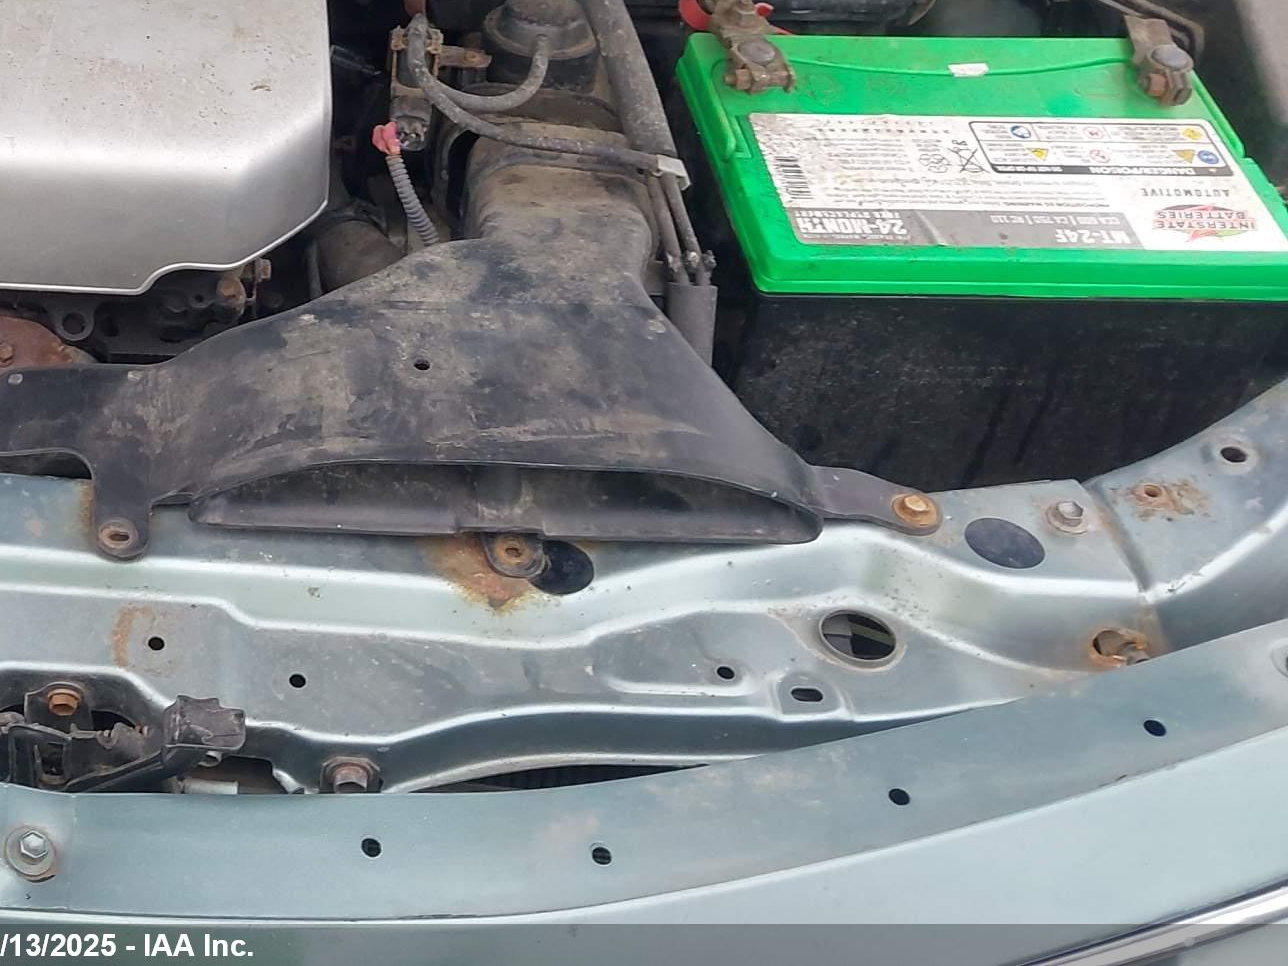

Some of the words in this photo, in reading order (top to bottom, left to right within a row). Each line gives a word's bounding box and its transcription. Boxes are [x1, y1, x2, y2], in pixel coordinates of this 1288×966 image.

[1141, 187, 1230, 196] AUTOMOTIVE
[1157, 211, 1245, 219] BATTERIES
[795, 217, 908, 235] 24-MONTH
[1156, 220, 1255, 229] INTERSTATE
[1054, 228, 1133, 244] MT-24F
